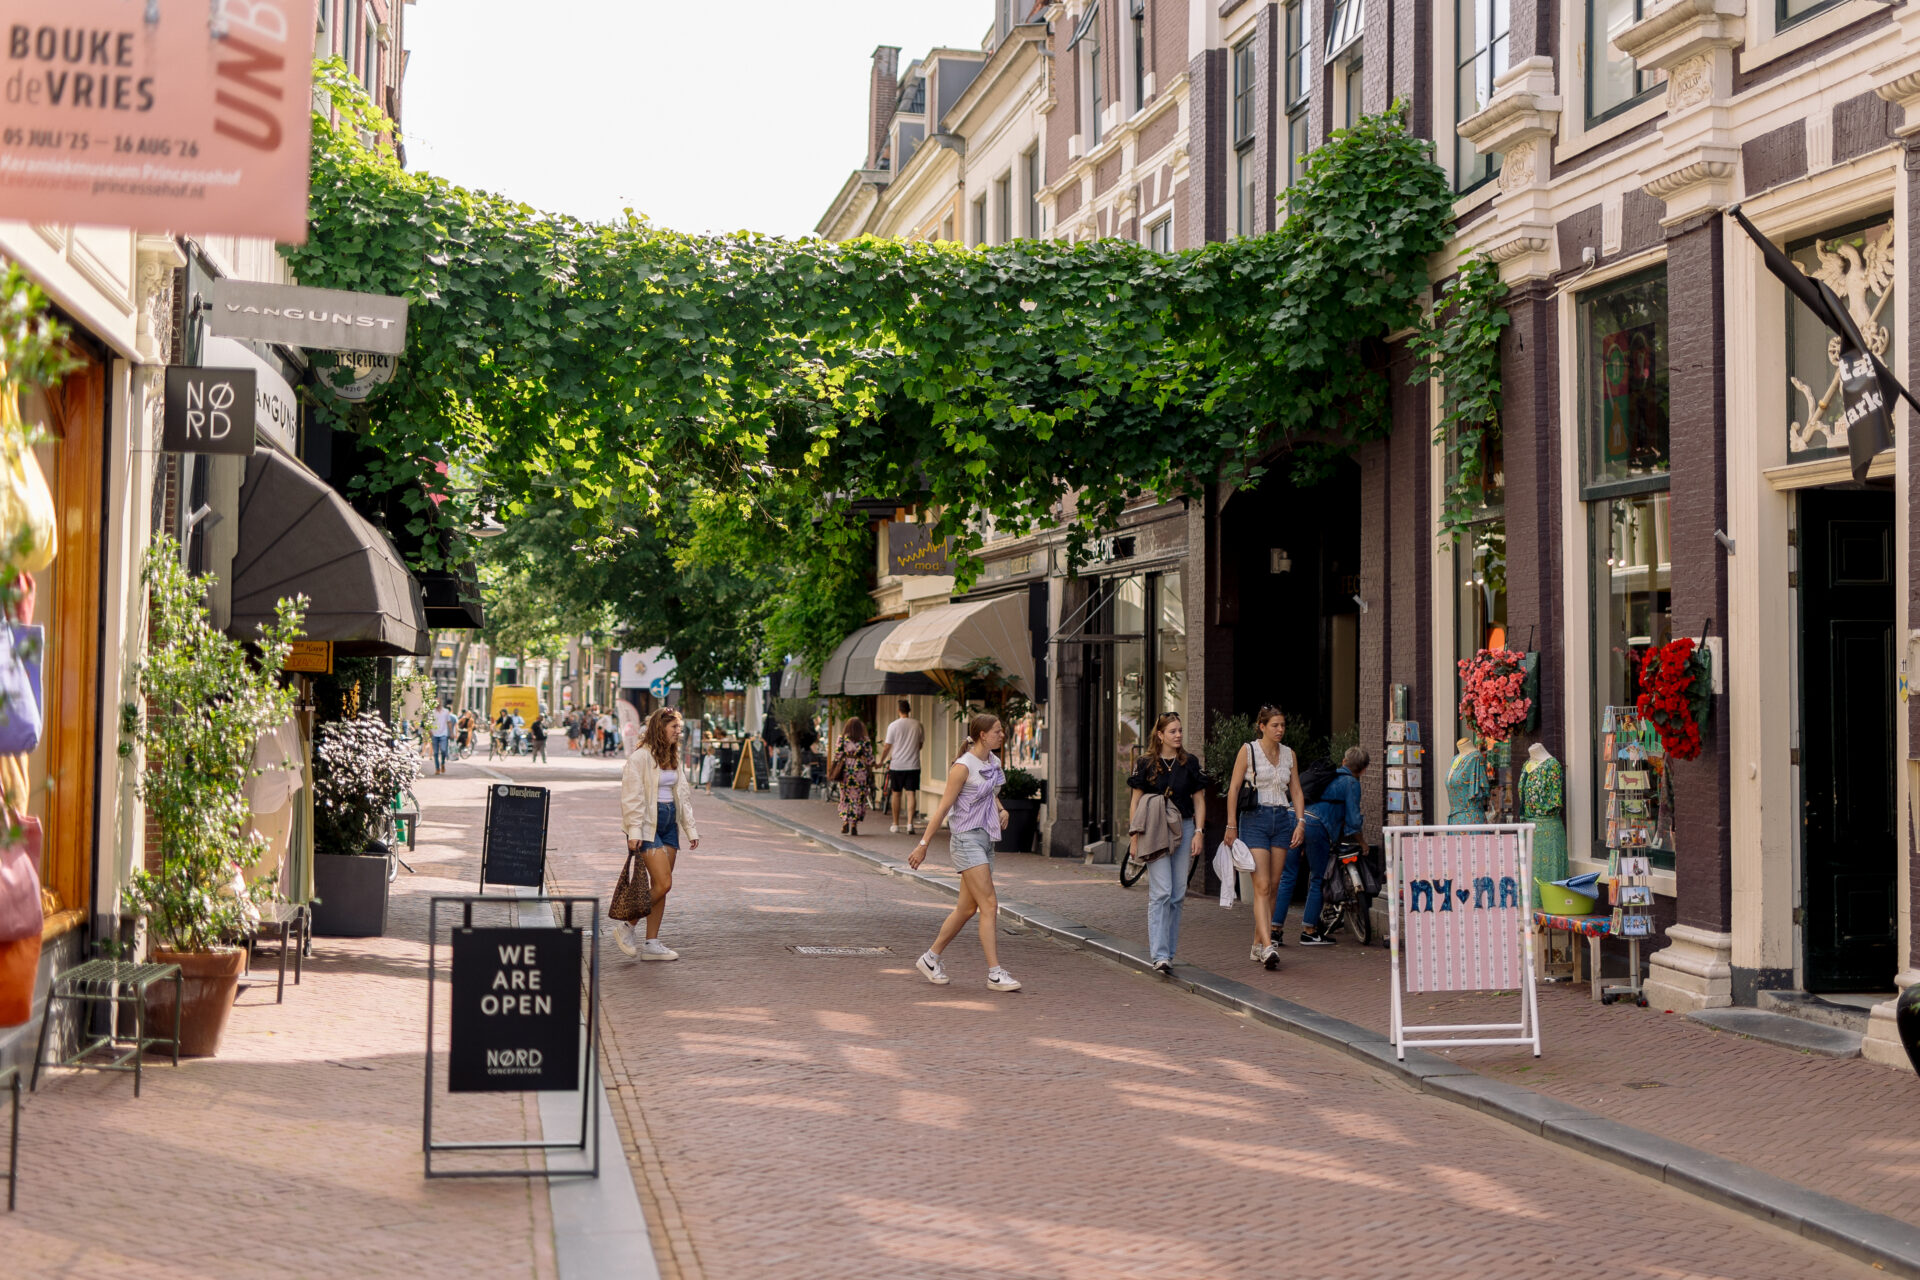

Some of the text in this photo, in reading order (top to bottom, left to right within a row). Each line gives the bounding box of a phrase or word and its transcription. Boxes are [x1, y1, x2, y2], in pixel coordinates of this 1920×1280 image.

[10, 24, 135, 67] BOUKE
[3, 127, 23, 147] 05
[27, 129, 62, 149] JULI
[114, 134, 133, 153] 16
[136, 137, 171, 156] AUG
[509, 787, 541, 799] Warsteiner
[498, 945, 537, 965] WE
[492, 970, 541, 990] ARE
[480, 995, 551, 1016] OPEN
